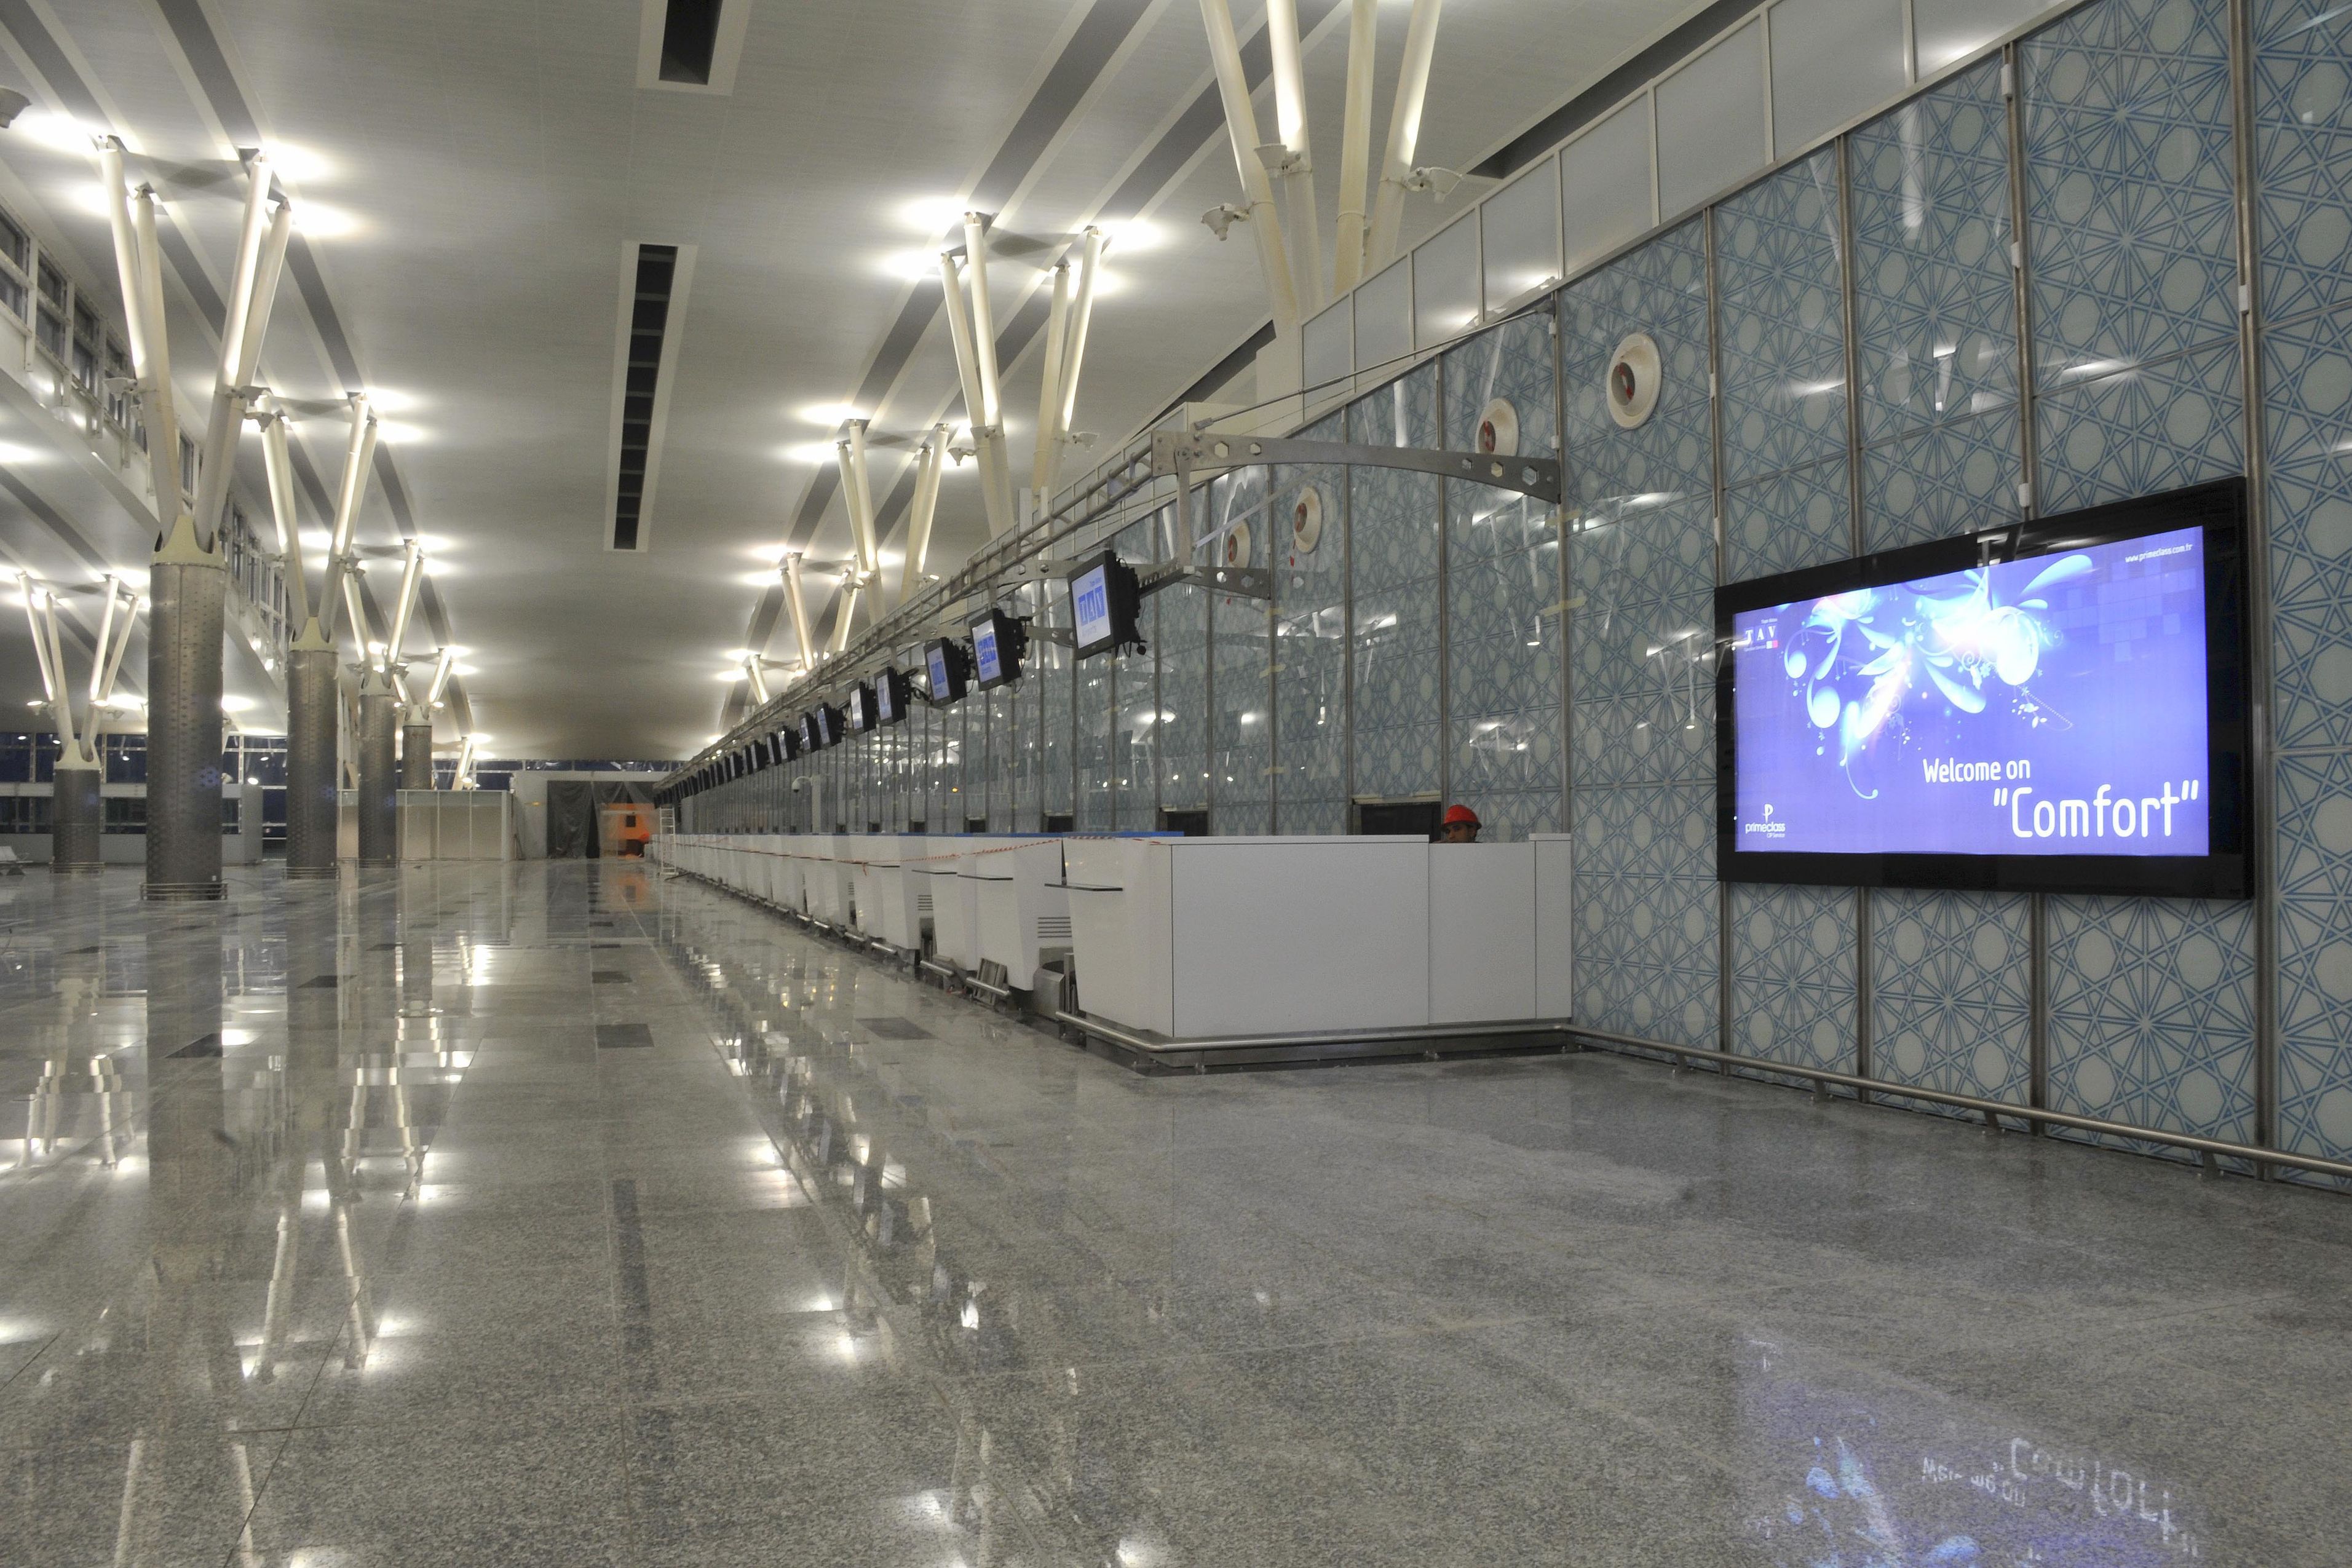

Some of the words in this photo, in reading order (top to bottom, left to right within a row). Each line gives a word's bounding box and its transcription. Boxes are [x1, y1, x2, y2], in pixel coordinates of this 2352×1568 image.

[2125, 543, 2193, 563] www.primeclass.com.tr
[1745, 625, 1776, 641] TAV
[1923, 757, 2002, 783] Welcome
[2006, 759, 2030, 779] on
[1993, 779, 2199, 838] "Comfort"
[1745, 822, 1786, 834] primeclass
